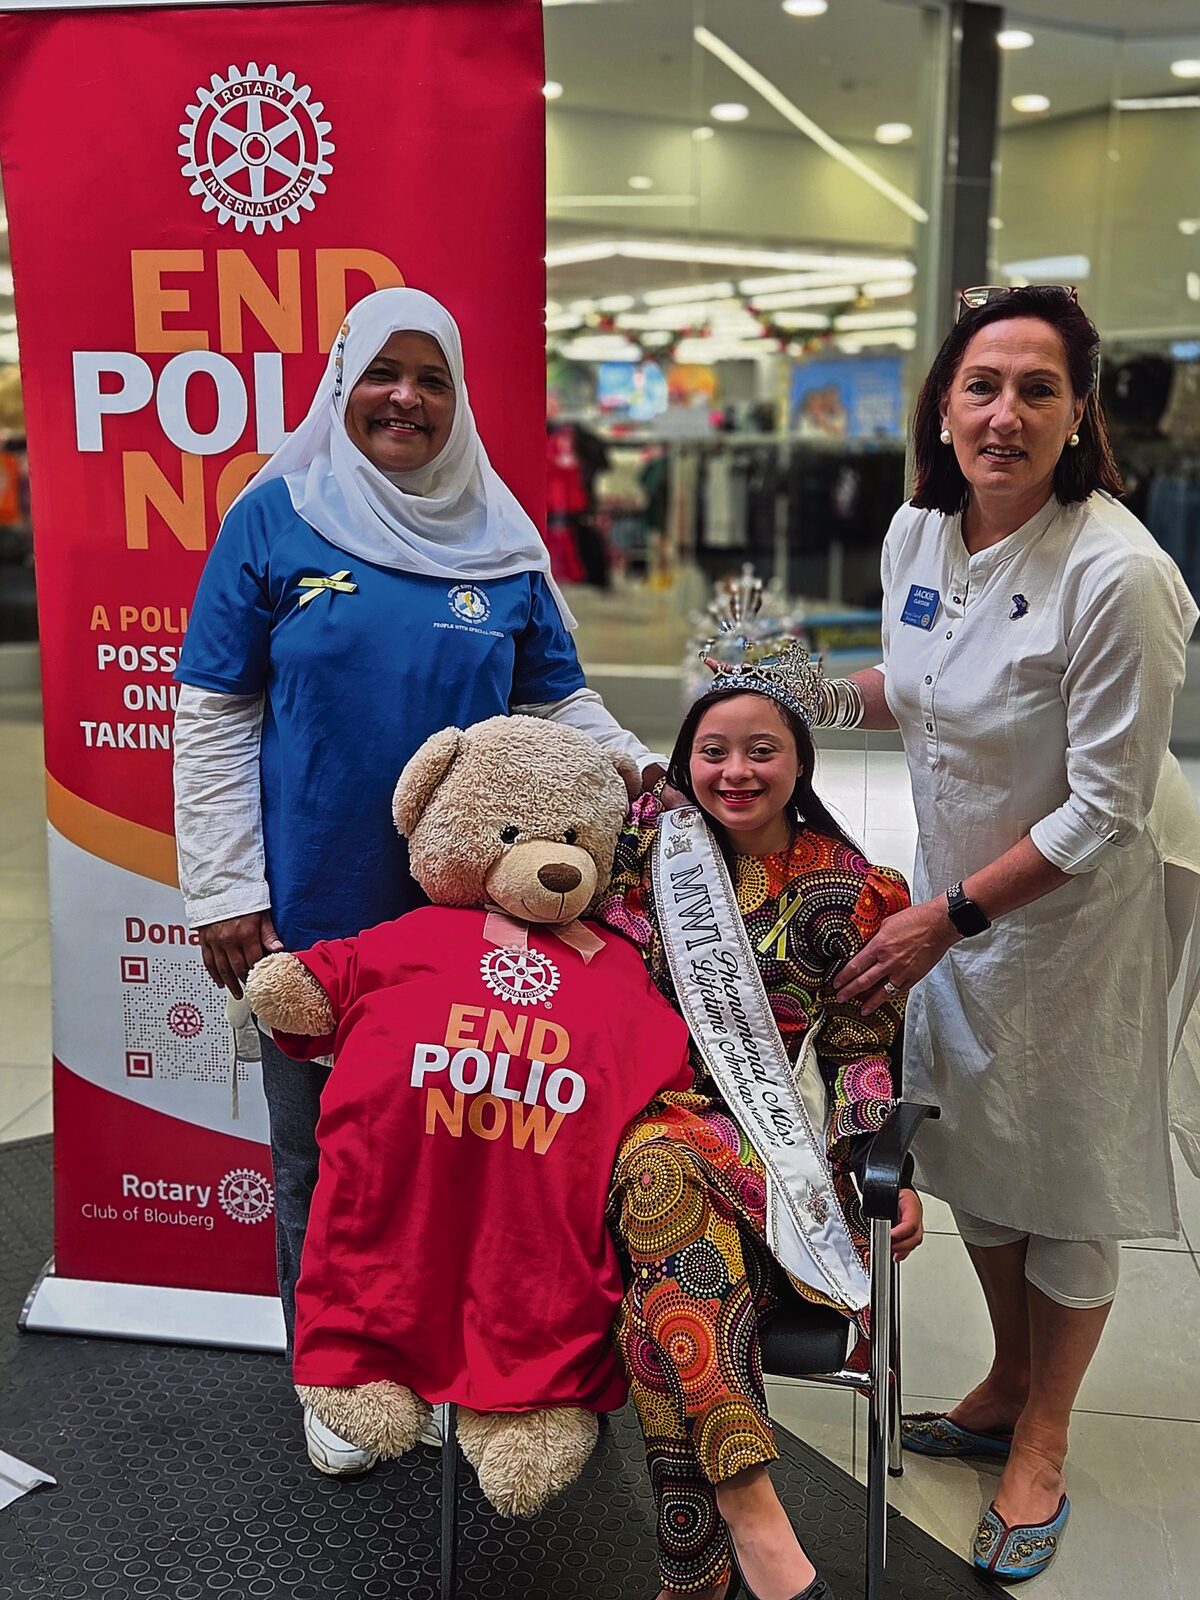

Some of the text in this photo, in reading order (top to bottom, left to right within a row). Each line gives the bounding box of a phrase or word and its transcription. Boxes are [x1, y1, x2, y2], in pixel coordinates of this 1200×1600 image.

[221, 81, 286, 102] ROTARY
[204, 173, 312, 216] INTERNATIONAL
[72, 350, 299, 455] POL
[90, 605, 189, 634] A POLI
[97, 644, 182, 673] POSS
[123, 684, 180, 712] ONL
[79, 721, 173, 750] TAKIN
[670, 863, 722, 951] MWI
[125, 916, 201, 946] Dona
[491, 974, 546, 998] INTERNATIONAL
[689, 959, 728, 1037] Lifetime
[444, 1003, 570, 1065] END
[712, 948, 778, 1087] Phenomenal
[410, 1043, 586, 1114] POLIO
[425, 1087, 567, 1156] NOW
[762, 1091, 796, 1146] Miss
[122, 1174, 211, 1208] Rotary
[81, 1203, 214, 1231] Club of Blouberg
